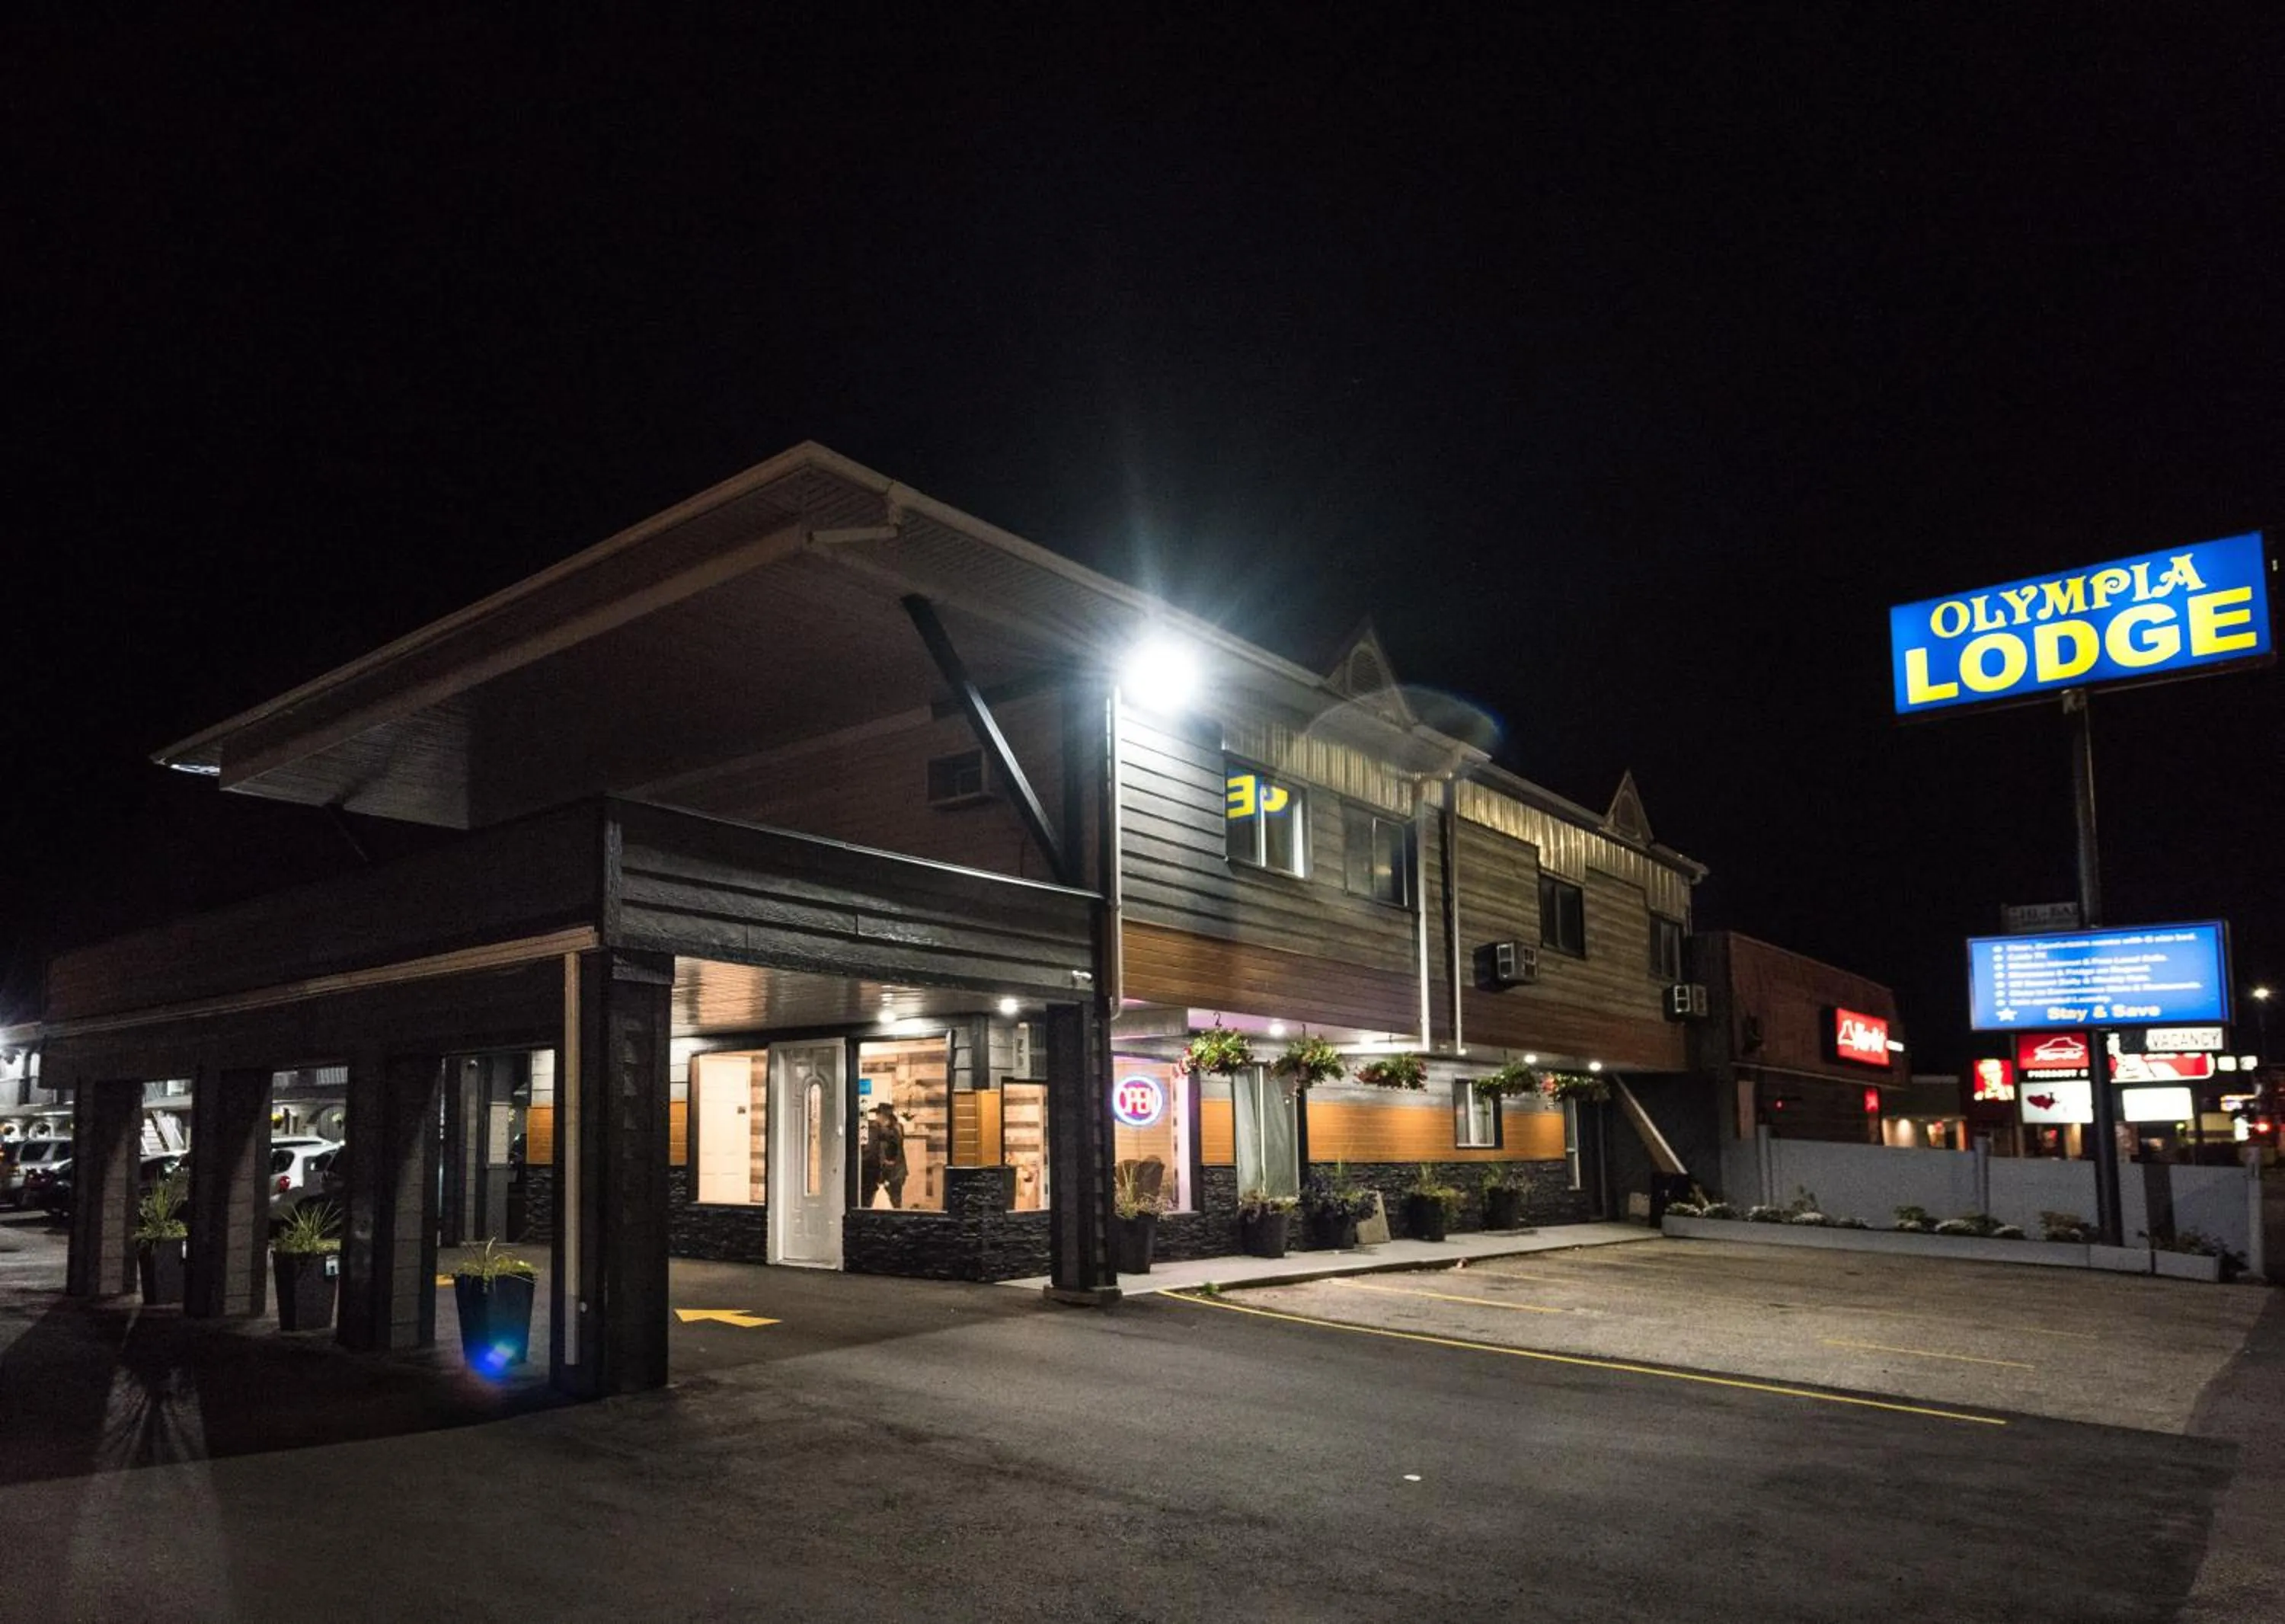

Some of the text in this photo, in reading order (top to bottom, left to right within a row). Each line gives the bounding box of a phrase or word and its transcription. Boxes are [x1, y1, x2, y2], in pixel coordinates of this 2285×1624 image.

[1930, 553, 2206, 638] OLYMPIA
[1905, 586, 2257, 705] LODGE
[2047, 1004, 2161, 1022] Stay & Save
[2150, 1030, 2219, 1047] VACANCY
